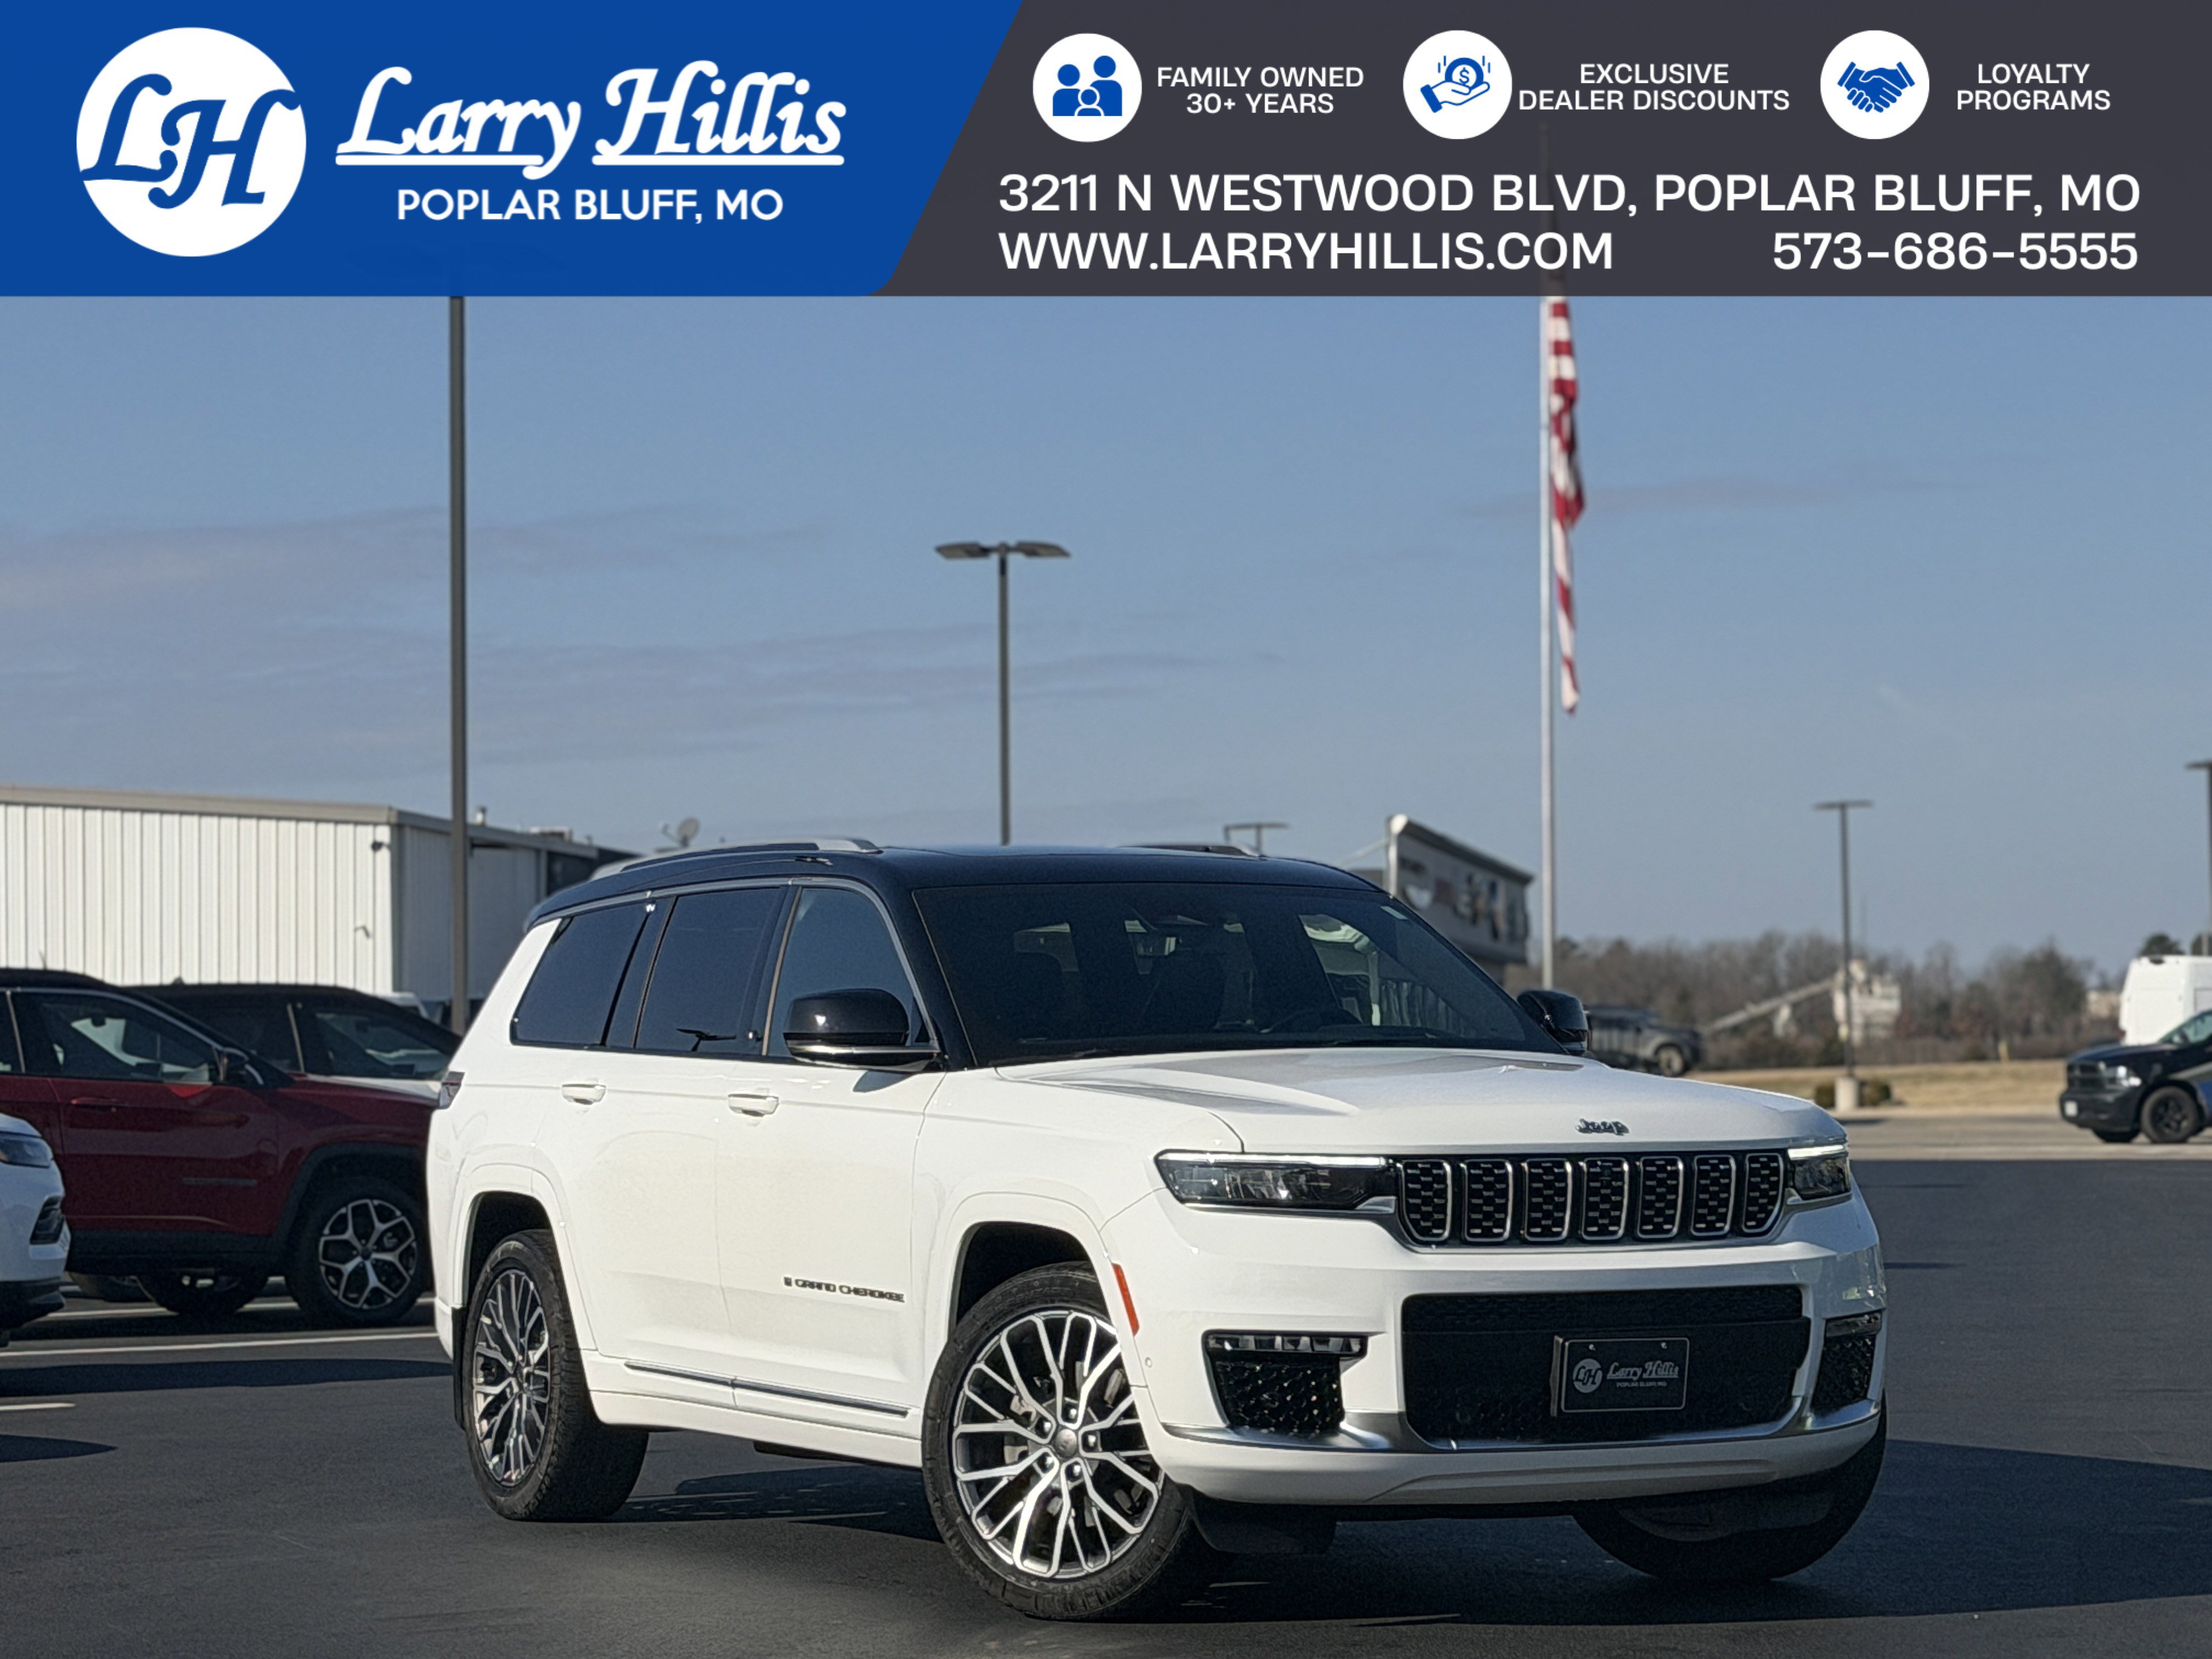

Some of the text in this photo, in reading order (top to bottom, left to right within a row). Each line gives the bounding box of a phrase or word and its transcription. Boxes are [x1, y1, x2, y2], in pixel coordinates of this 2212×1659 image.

[1575, 1118, 1630, 1136] Jeep
[1606, 1360, 1679, 1381] Larry Hillis
